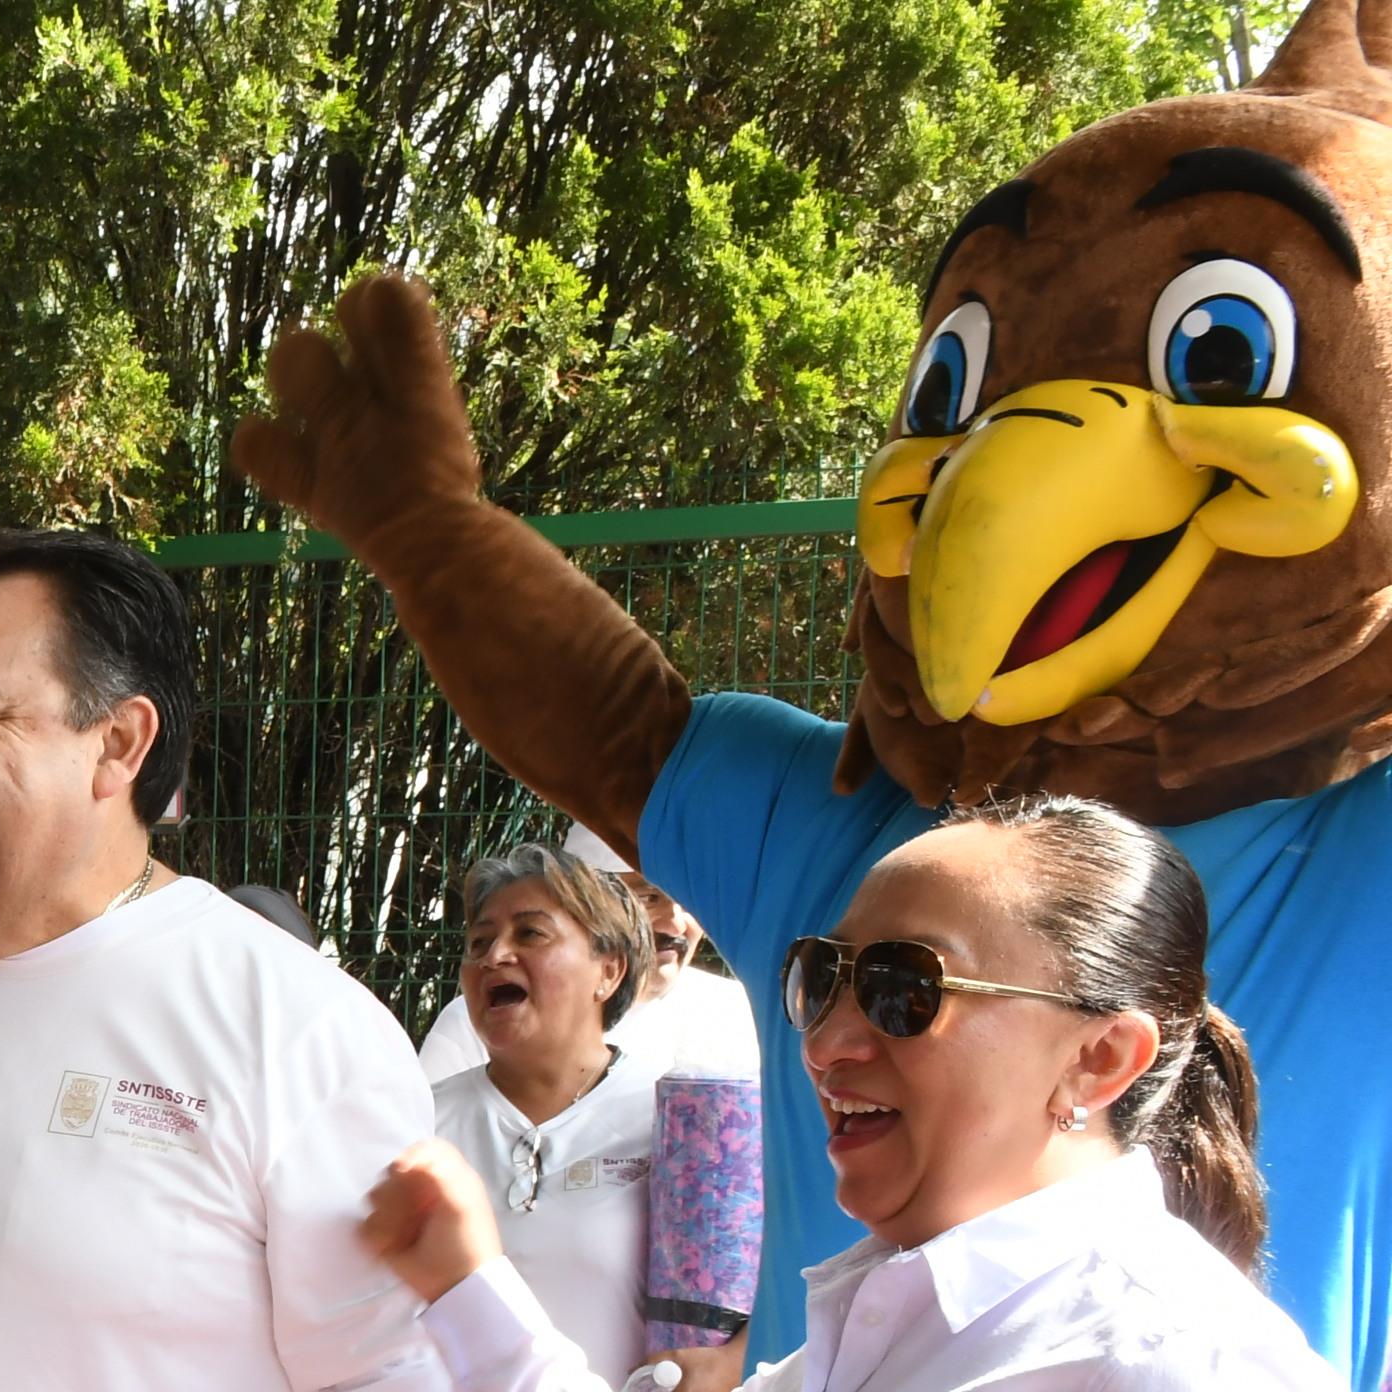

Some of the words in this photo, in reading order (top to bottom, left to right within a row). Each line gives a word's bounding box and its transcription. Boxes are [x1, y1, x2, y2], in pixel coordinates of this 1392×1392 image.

[117, 1080, 207, 1112] SNTISSSTE
[111, 1099, 160, 1116] SINDICATO
[113, 1107, 127, 1117] DE
[128, 1118, 146, 1128] DEL
[148, 1121, 182, 1136] ISSSTE
